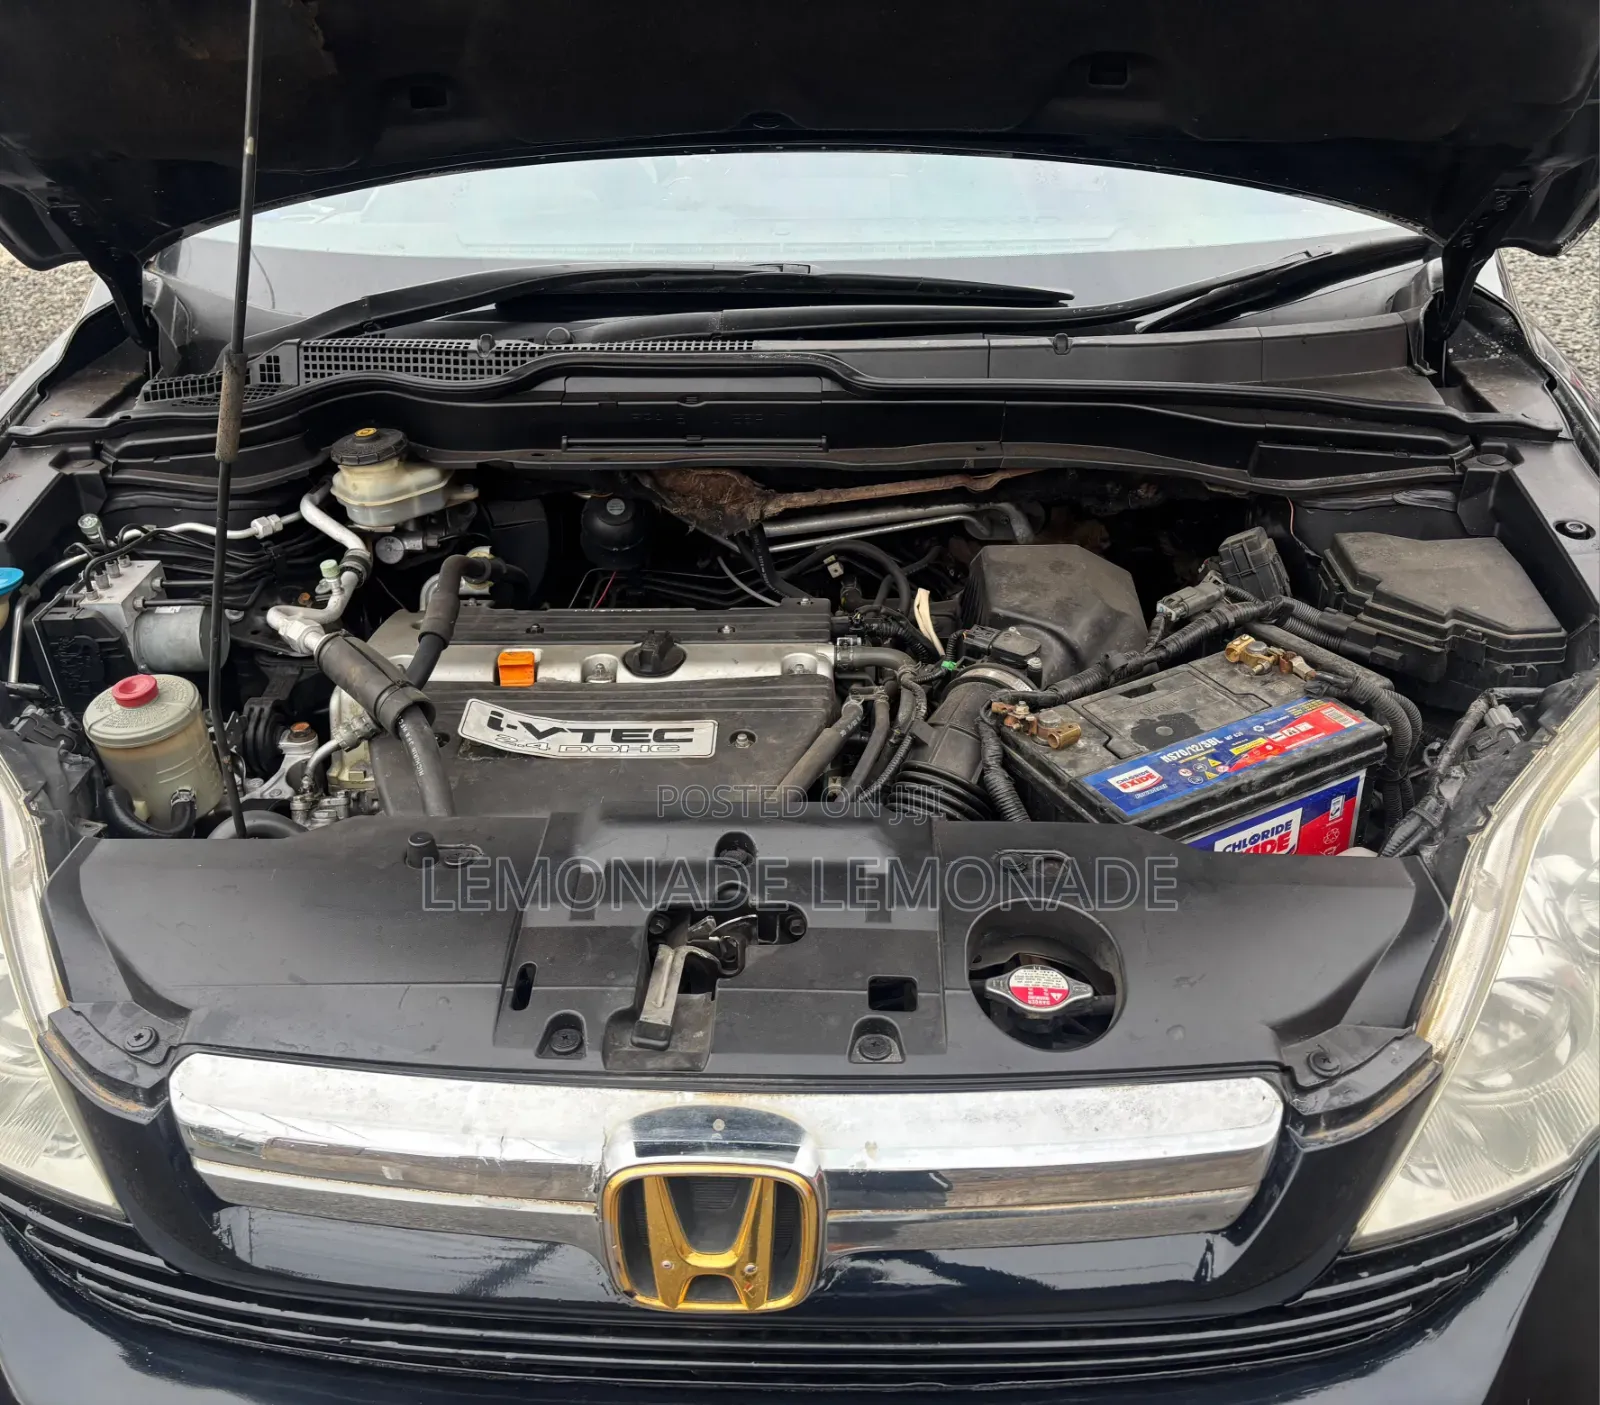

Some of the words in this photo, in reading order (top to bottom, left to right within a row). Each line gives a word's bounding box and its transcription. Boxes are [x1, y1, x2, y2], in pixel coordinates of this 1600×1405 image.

[487, 710, 694, 744] i-VTEC
[494, 734, 551, 751] 2.4
[558, 744, 680, 753] DOHC
[1120, 772, 1157, 790] EXIDE
[1222, 819, 1294, 853] CHLORIDE
